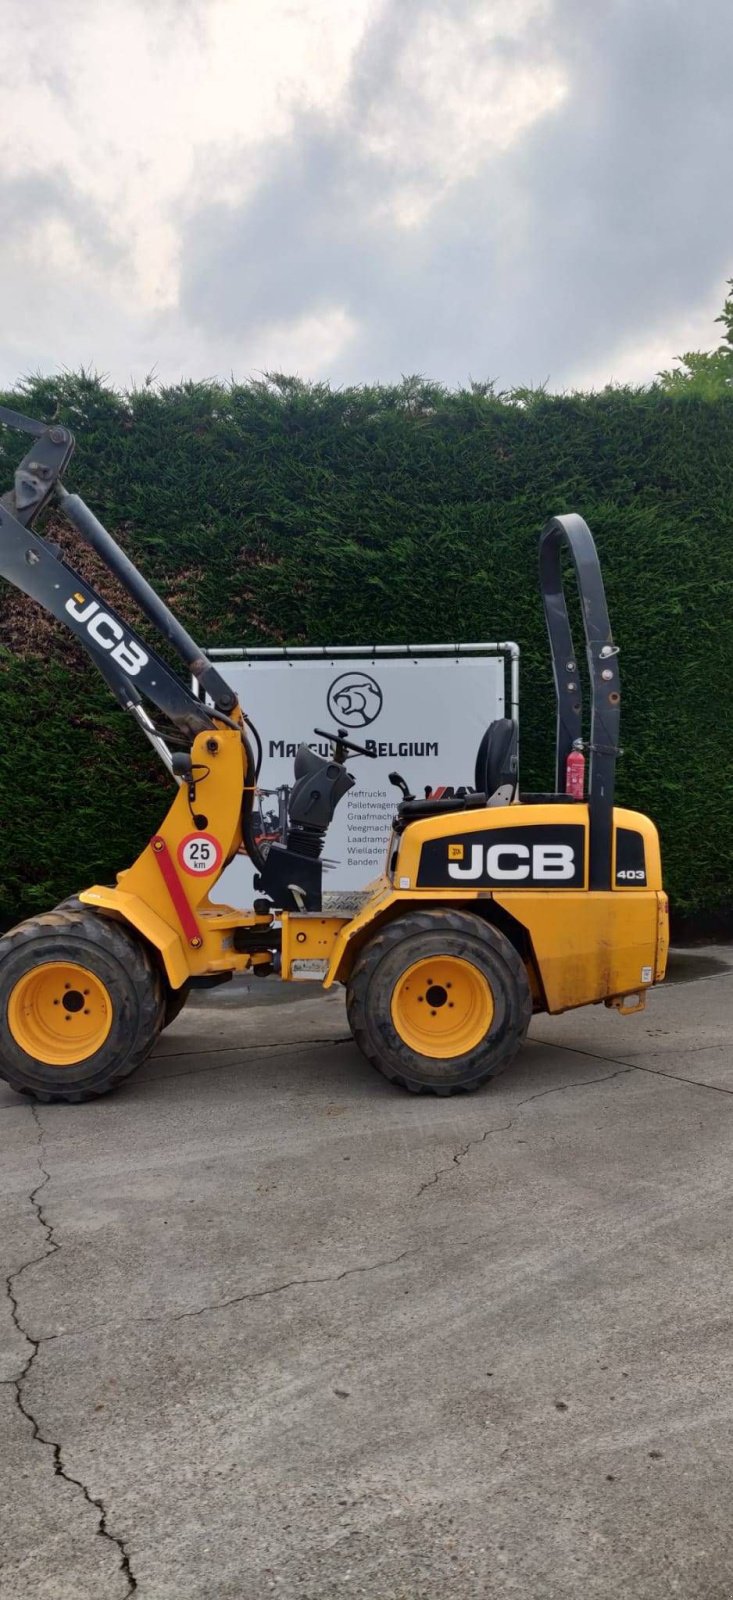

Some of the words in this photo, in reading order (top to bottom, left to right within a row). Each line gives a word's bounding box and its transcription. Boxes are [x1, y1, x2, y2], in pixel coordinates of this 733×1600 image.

[65, 593, 149, 676] JCB
[347, 790, 387, 798] Heftrucks
[190, 843, 210, 860] 25
[193, 860, 206, 869] km
[347, 858, 379, 866] Banden
[448, 844, 576, 880] JCB
[616, 870, 645, 880] 403
